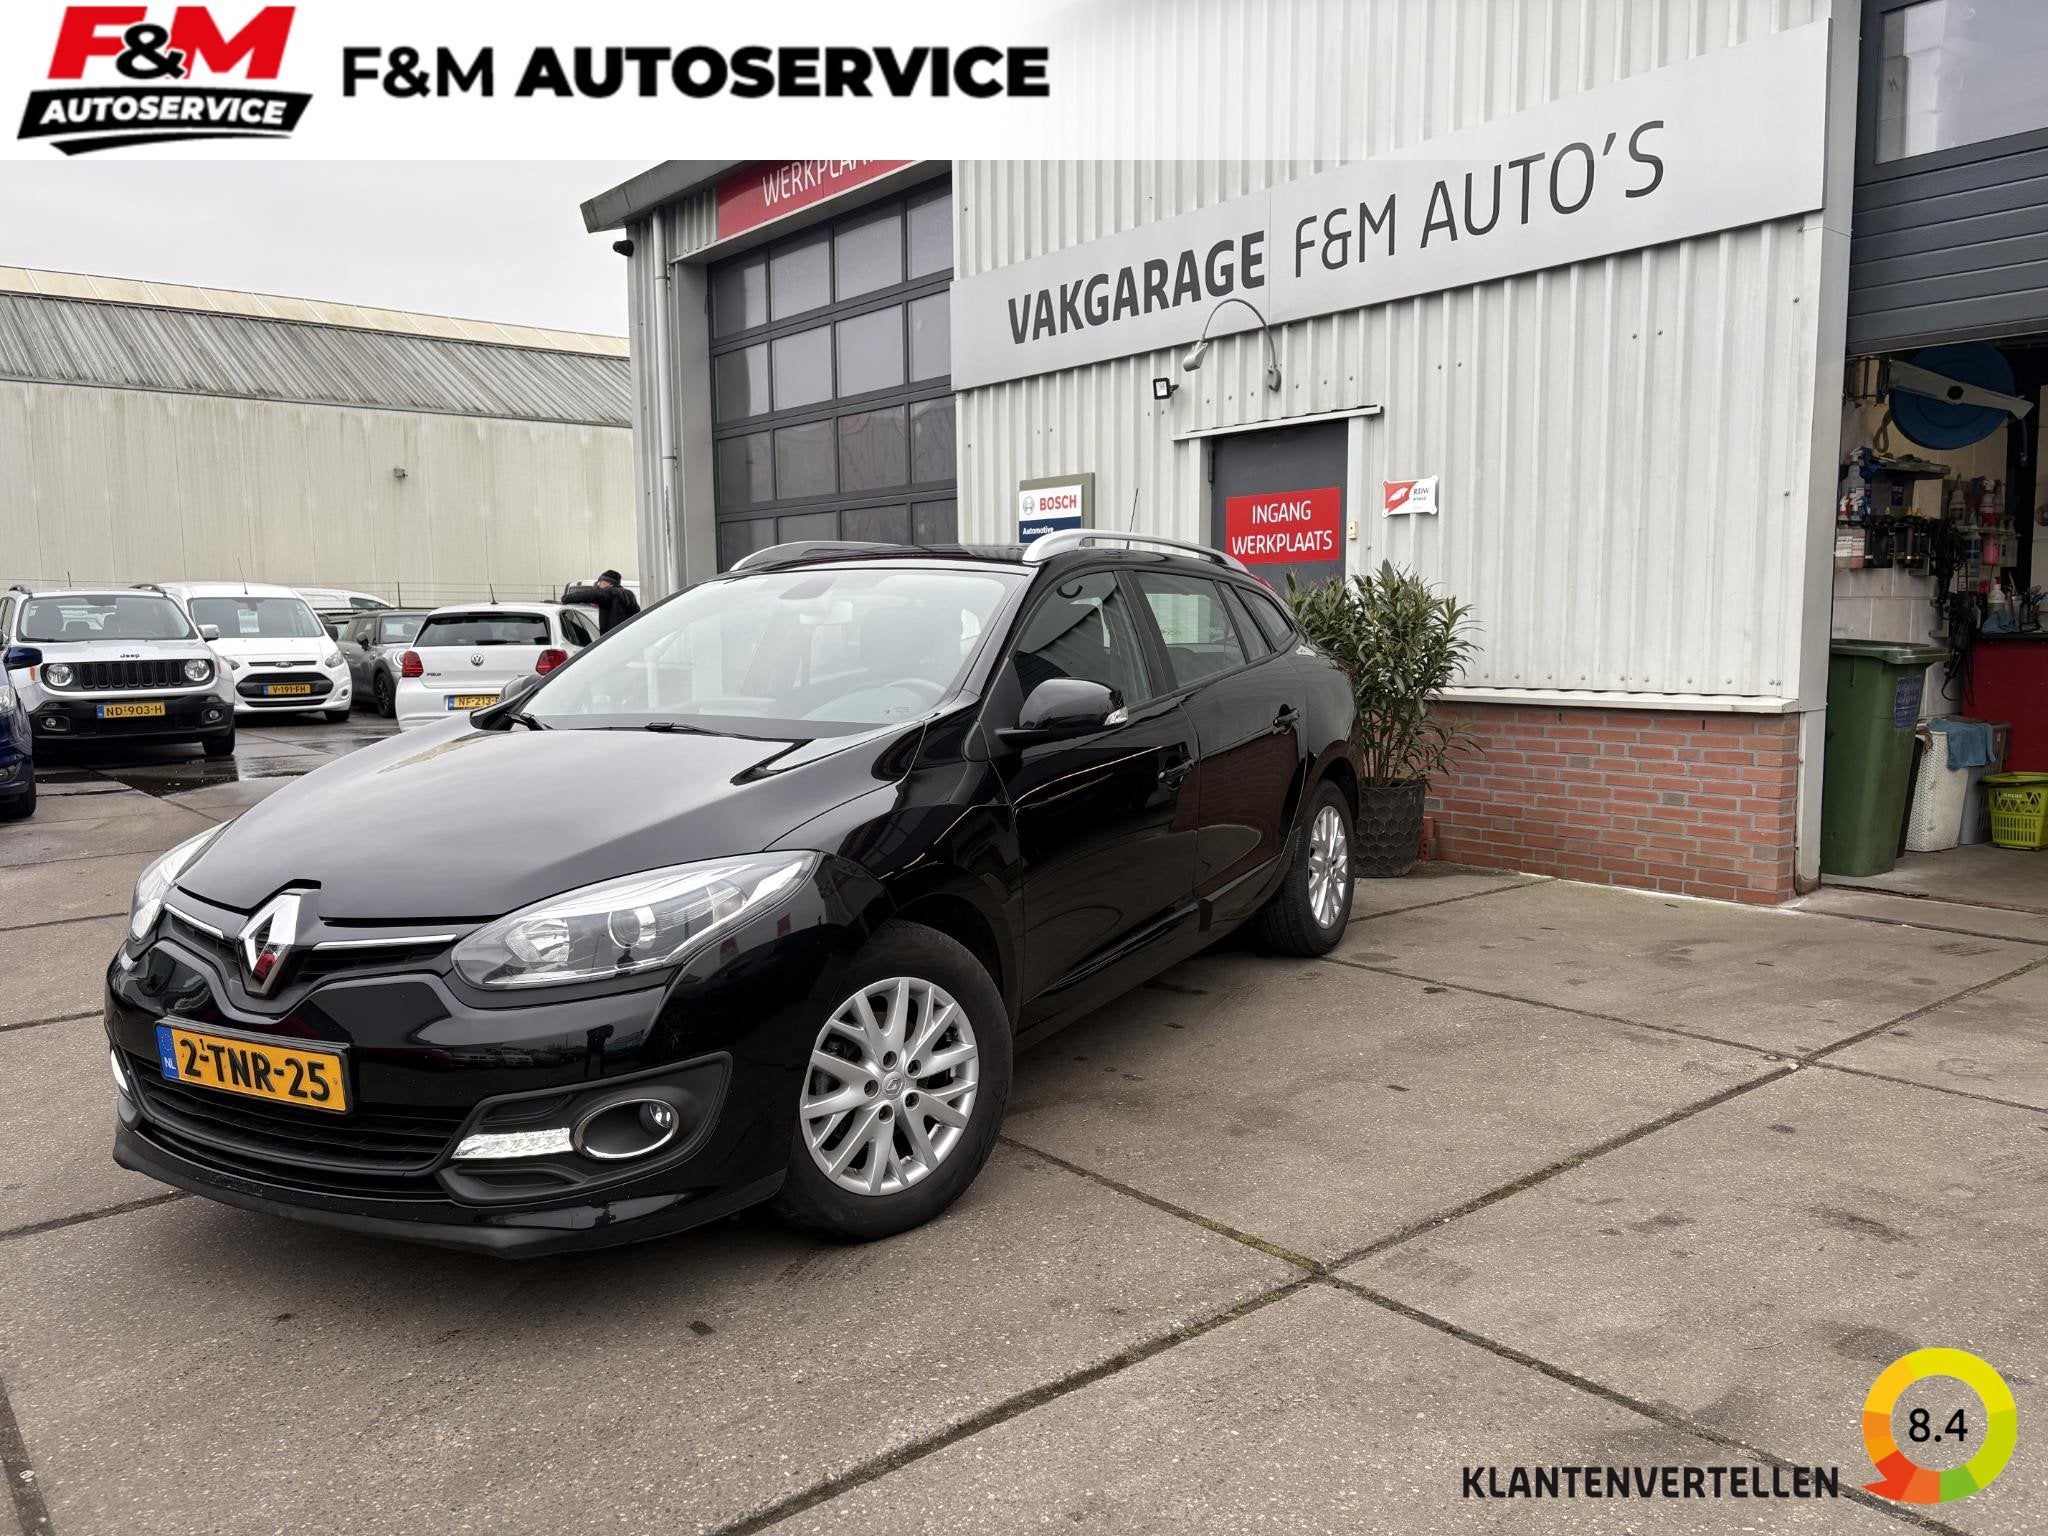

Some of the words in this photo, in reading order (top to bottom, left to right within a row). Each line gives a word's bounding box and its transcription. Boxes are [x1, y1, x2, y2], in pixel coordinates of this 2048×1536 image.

[1007, 229, 1265, 346] VAKGARAGE
[1295, 193, 1396, 279] F&M
[1420, 120, 1664, 249] AUTO'S
[1039, 494, 1077, 511] BOSCH
[1252, 500, 1311, 525] INGANG
[1023, 525, 1054, 535] Automotive
[1231, 530, 1333, 556] WERKPLAATS
[106, 705, 162, 717] ND-903-H
[163, 1056, 177, 1070] NL
[179, 1037, 331, 1102] 2-TNR-25
